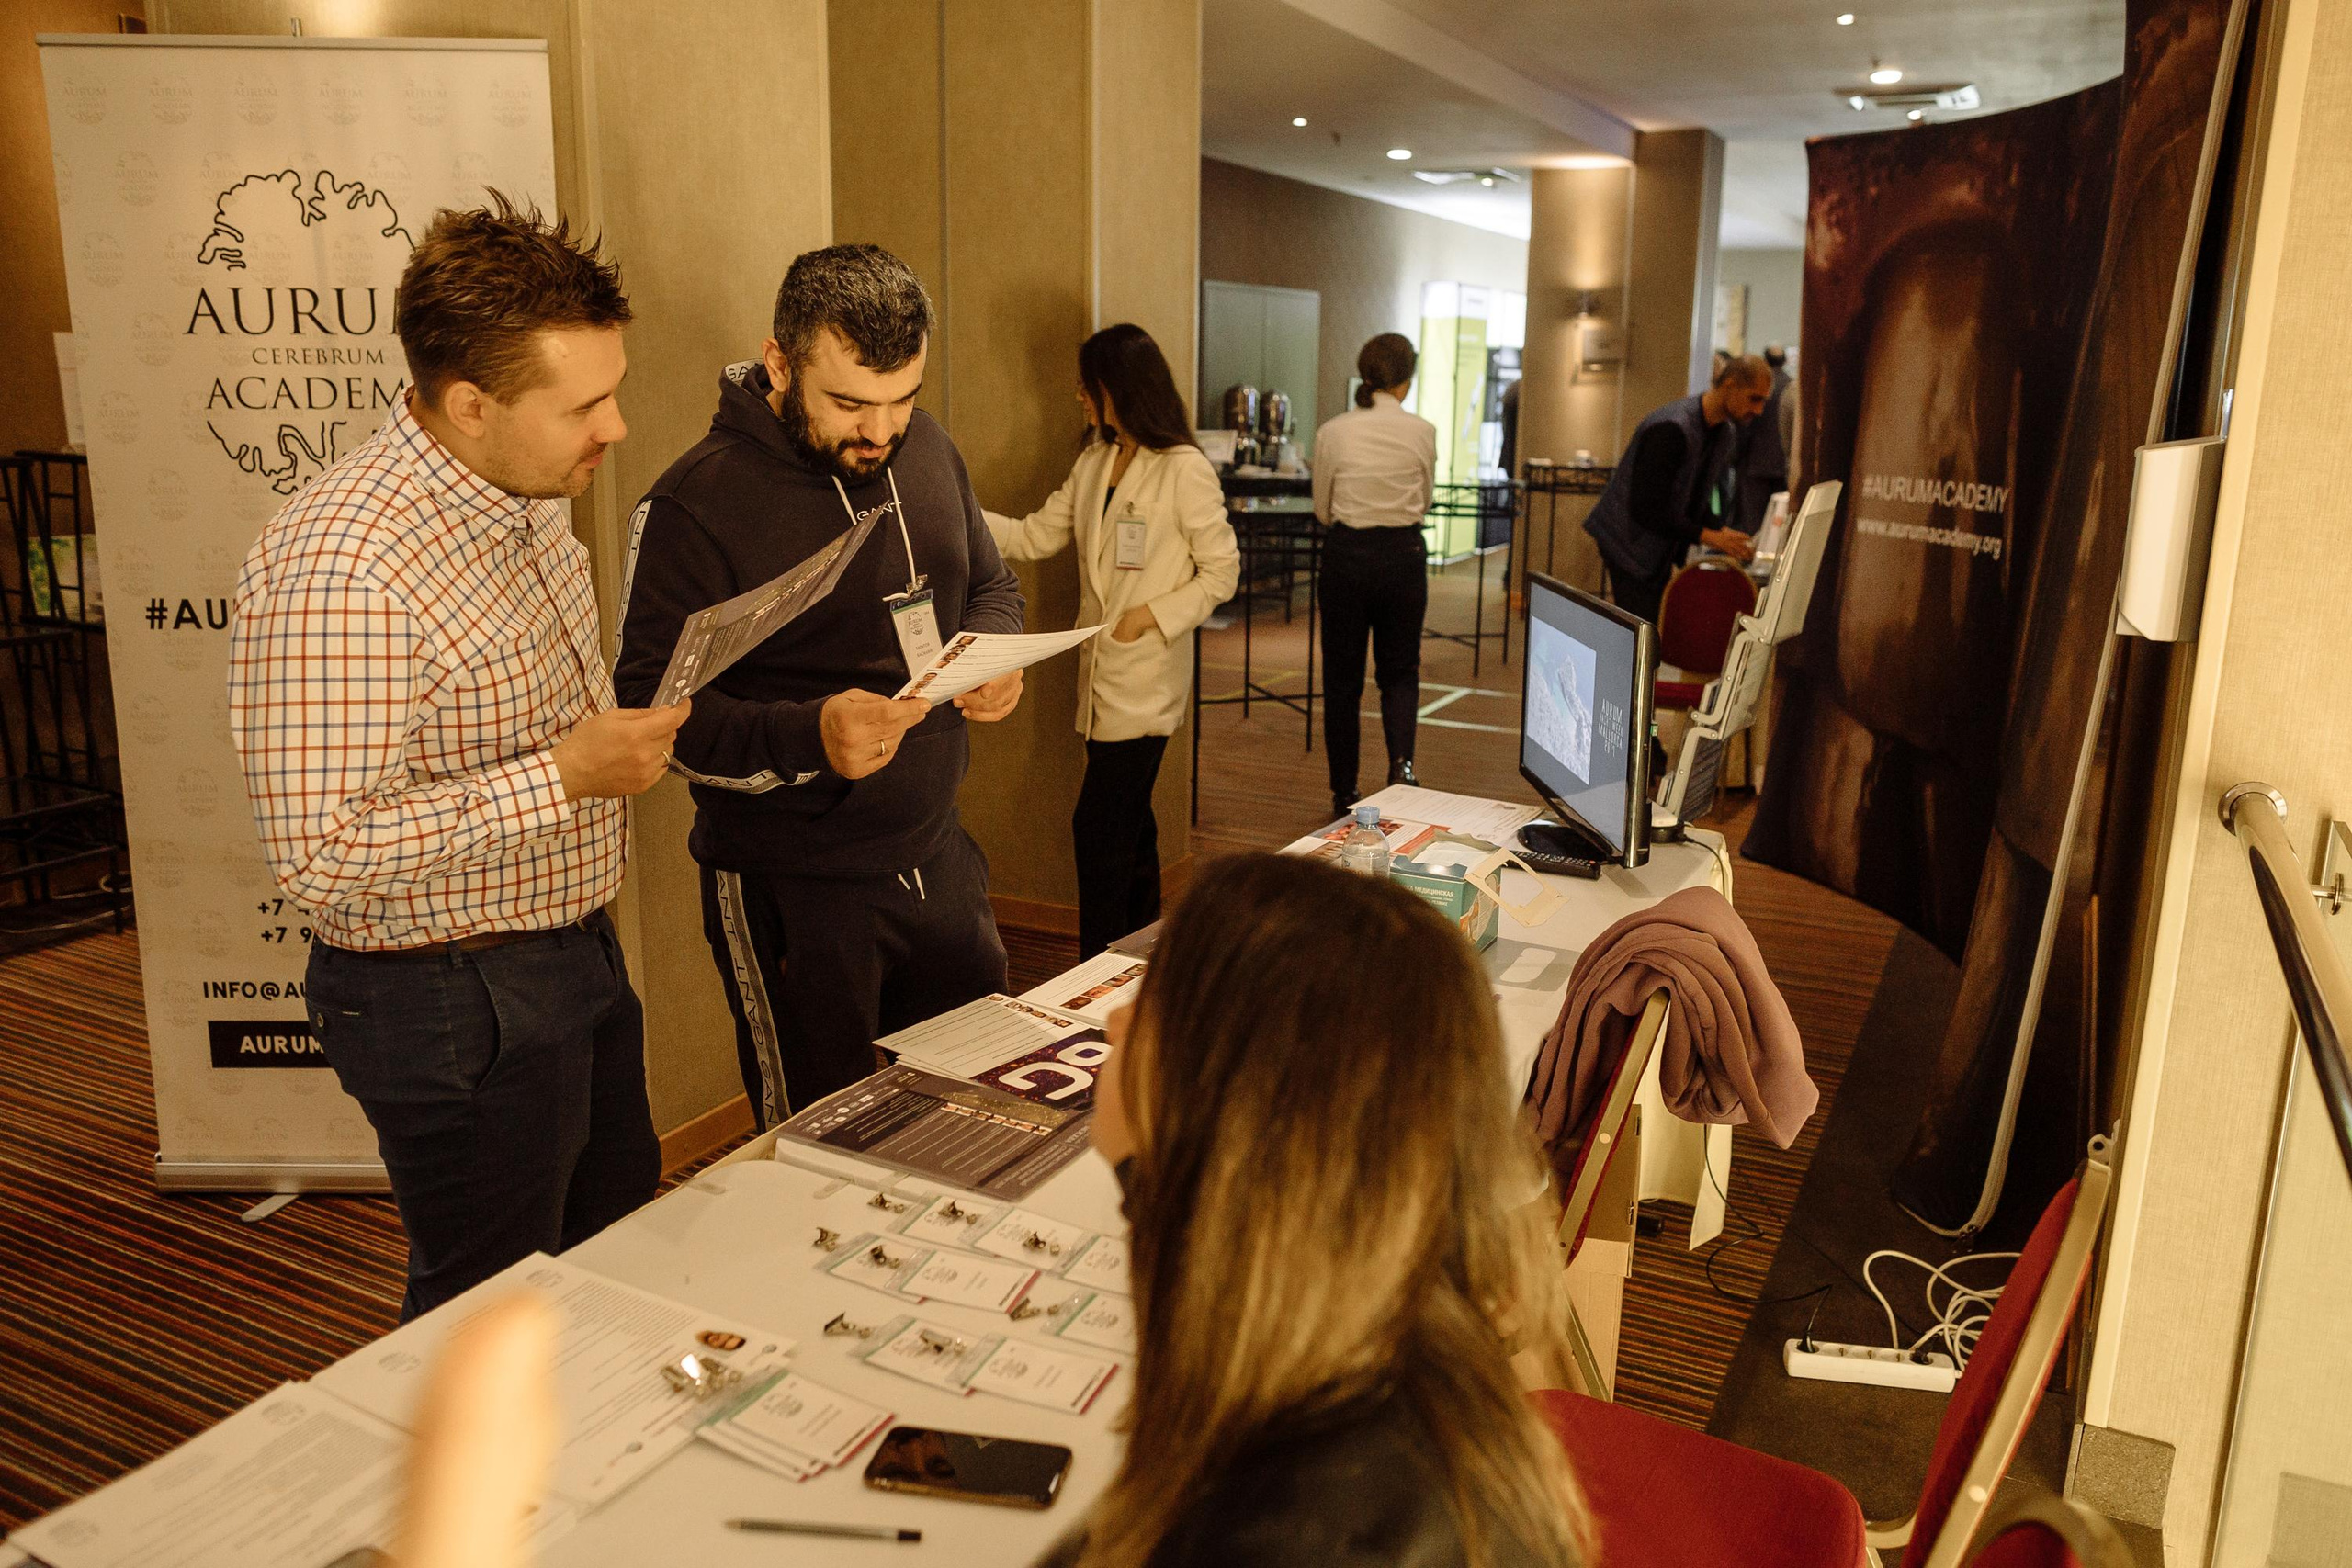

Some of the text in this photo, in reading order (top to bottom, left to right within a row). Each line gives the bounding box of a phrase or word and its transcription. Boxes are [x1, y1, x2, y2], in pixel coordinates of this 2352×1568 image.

[182, 287, 400, 335] AURU
[252, 347, 385, 365] CEREBRUM
[205, 376, 405, 410] ACADEM
[1861, 475, 2009, 514] #AURUMACADEMY
[1856, 518, 2003, 561] www.aurumacademy.org
[145, 598, 237, 630] #AU
[1601, 698, 1623, 723] AURUM
[258, 898, 285, 916] +7
[261, 927, 288, 943] +7
[240, 1035, 324, 1054] AURUM
